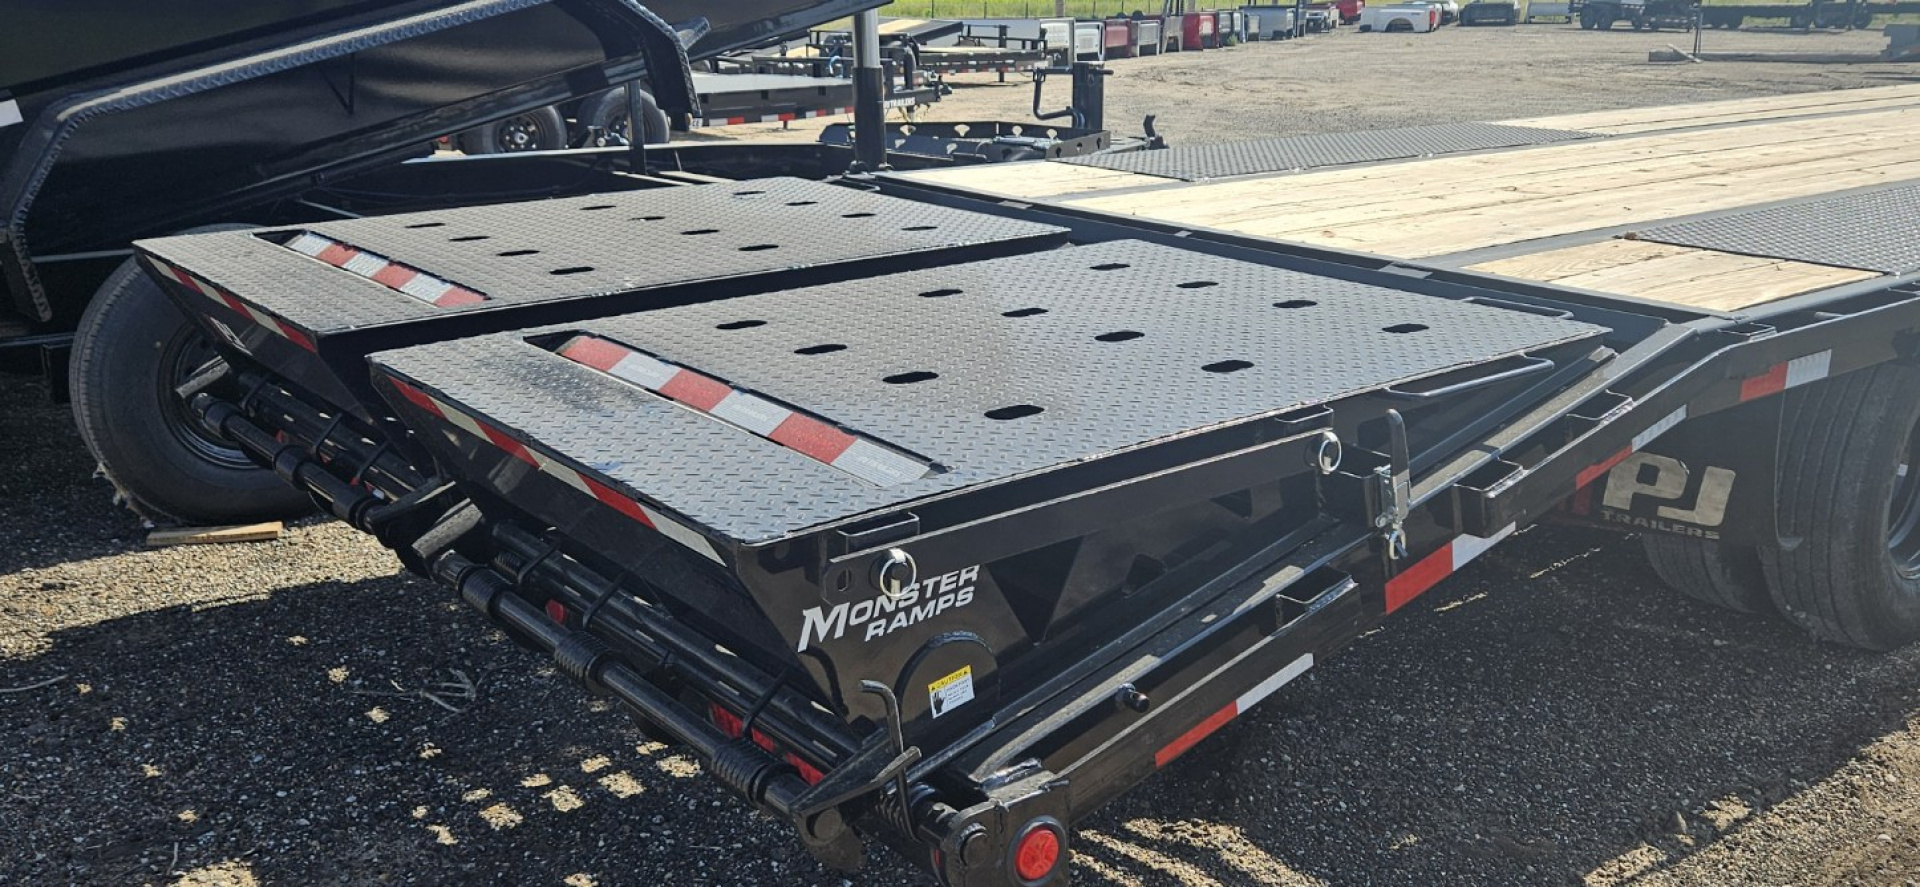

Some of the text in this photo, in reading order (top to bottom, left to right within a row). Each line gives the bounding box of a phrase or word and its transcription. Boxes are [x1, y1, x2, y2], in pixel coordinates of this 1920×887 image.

[1602, 451, 1737, 527] PJ
[1600, 509, 1720, 540] TRAILERS
[798, 564, 981, 653] MONSTER
[864, 586, 975, 642] RAMPS
